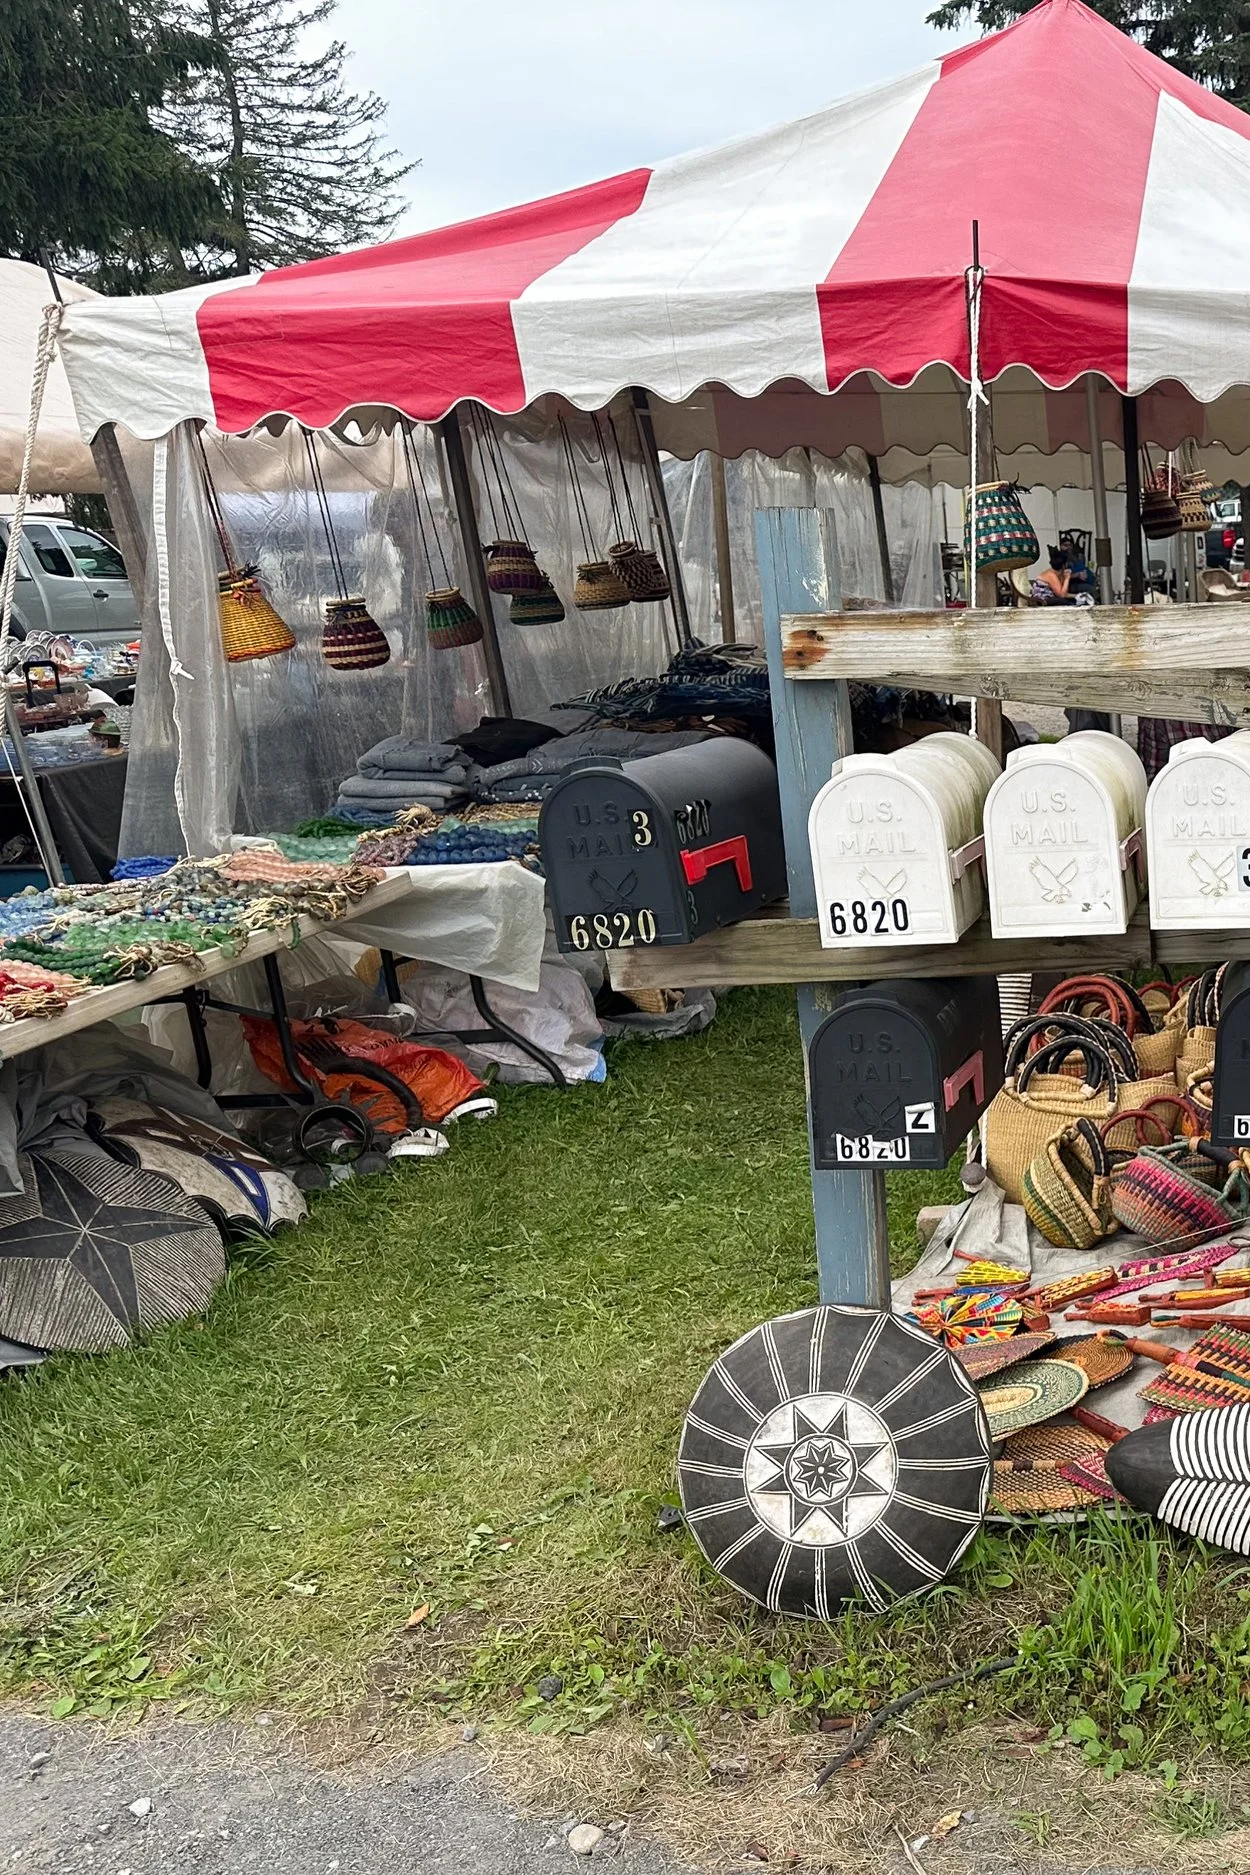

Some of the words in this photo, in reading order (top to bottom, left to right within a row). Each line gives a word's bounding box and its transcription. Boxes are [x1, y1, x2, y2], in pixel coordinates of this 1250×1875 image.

[633, 810, 652, 846] 3
[1011, 822, 1088, 846] MAIL
[1172, 814, 1247, 838] MAIL
[840, 832, 917, 856] MAIL
[571, 908, 656, 950] 6820
[830, 900, 910, 935] 6820
[836, 1060, 912, 1083] MAIL
